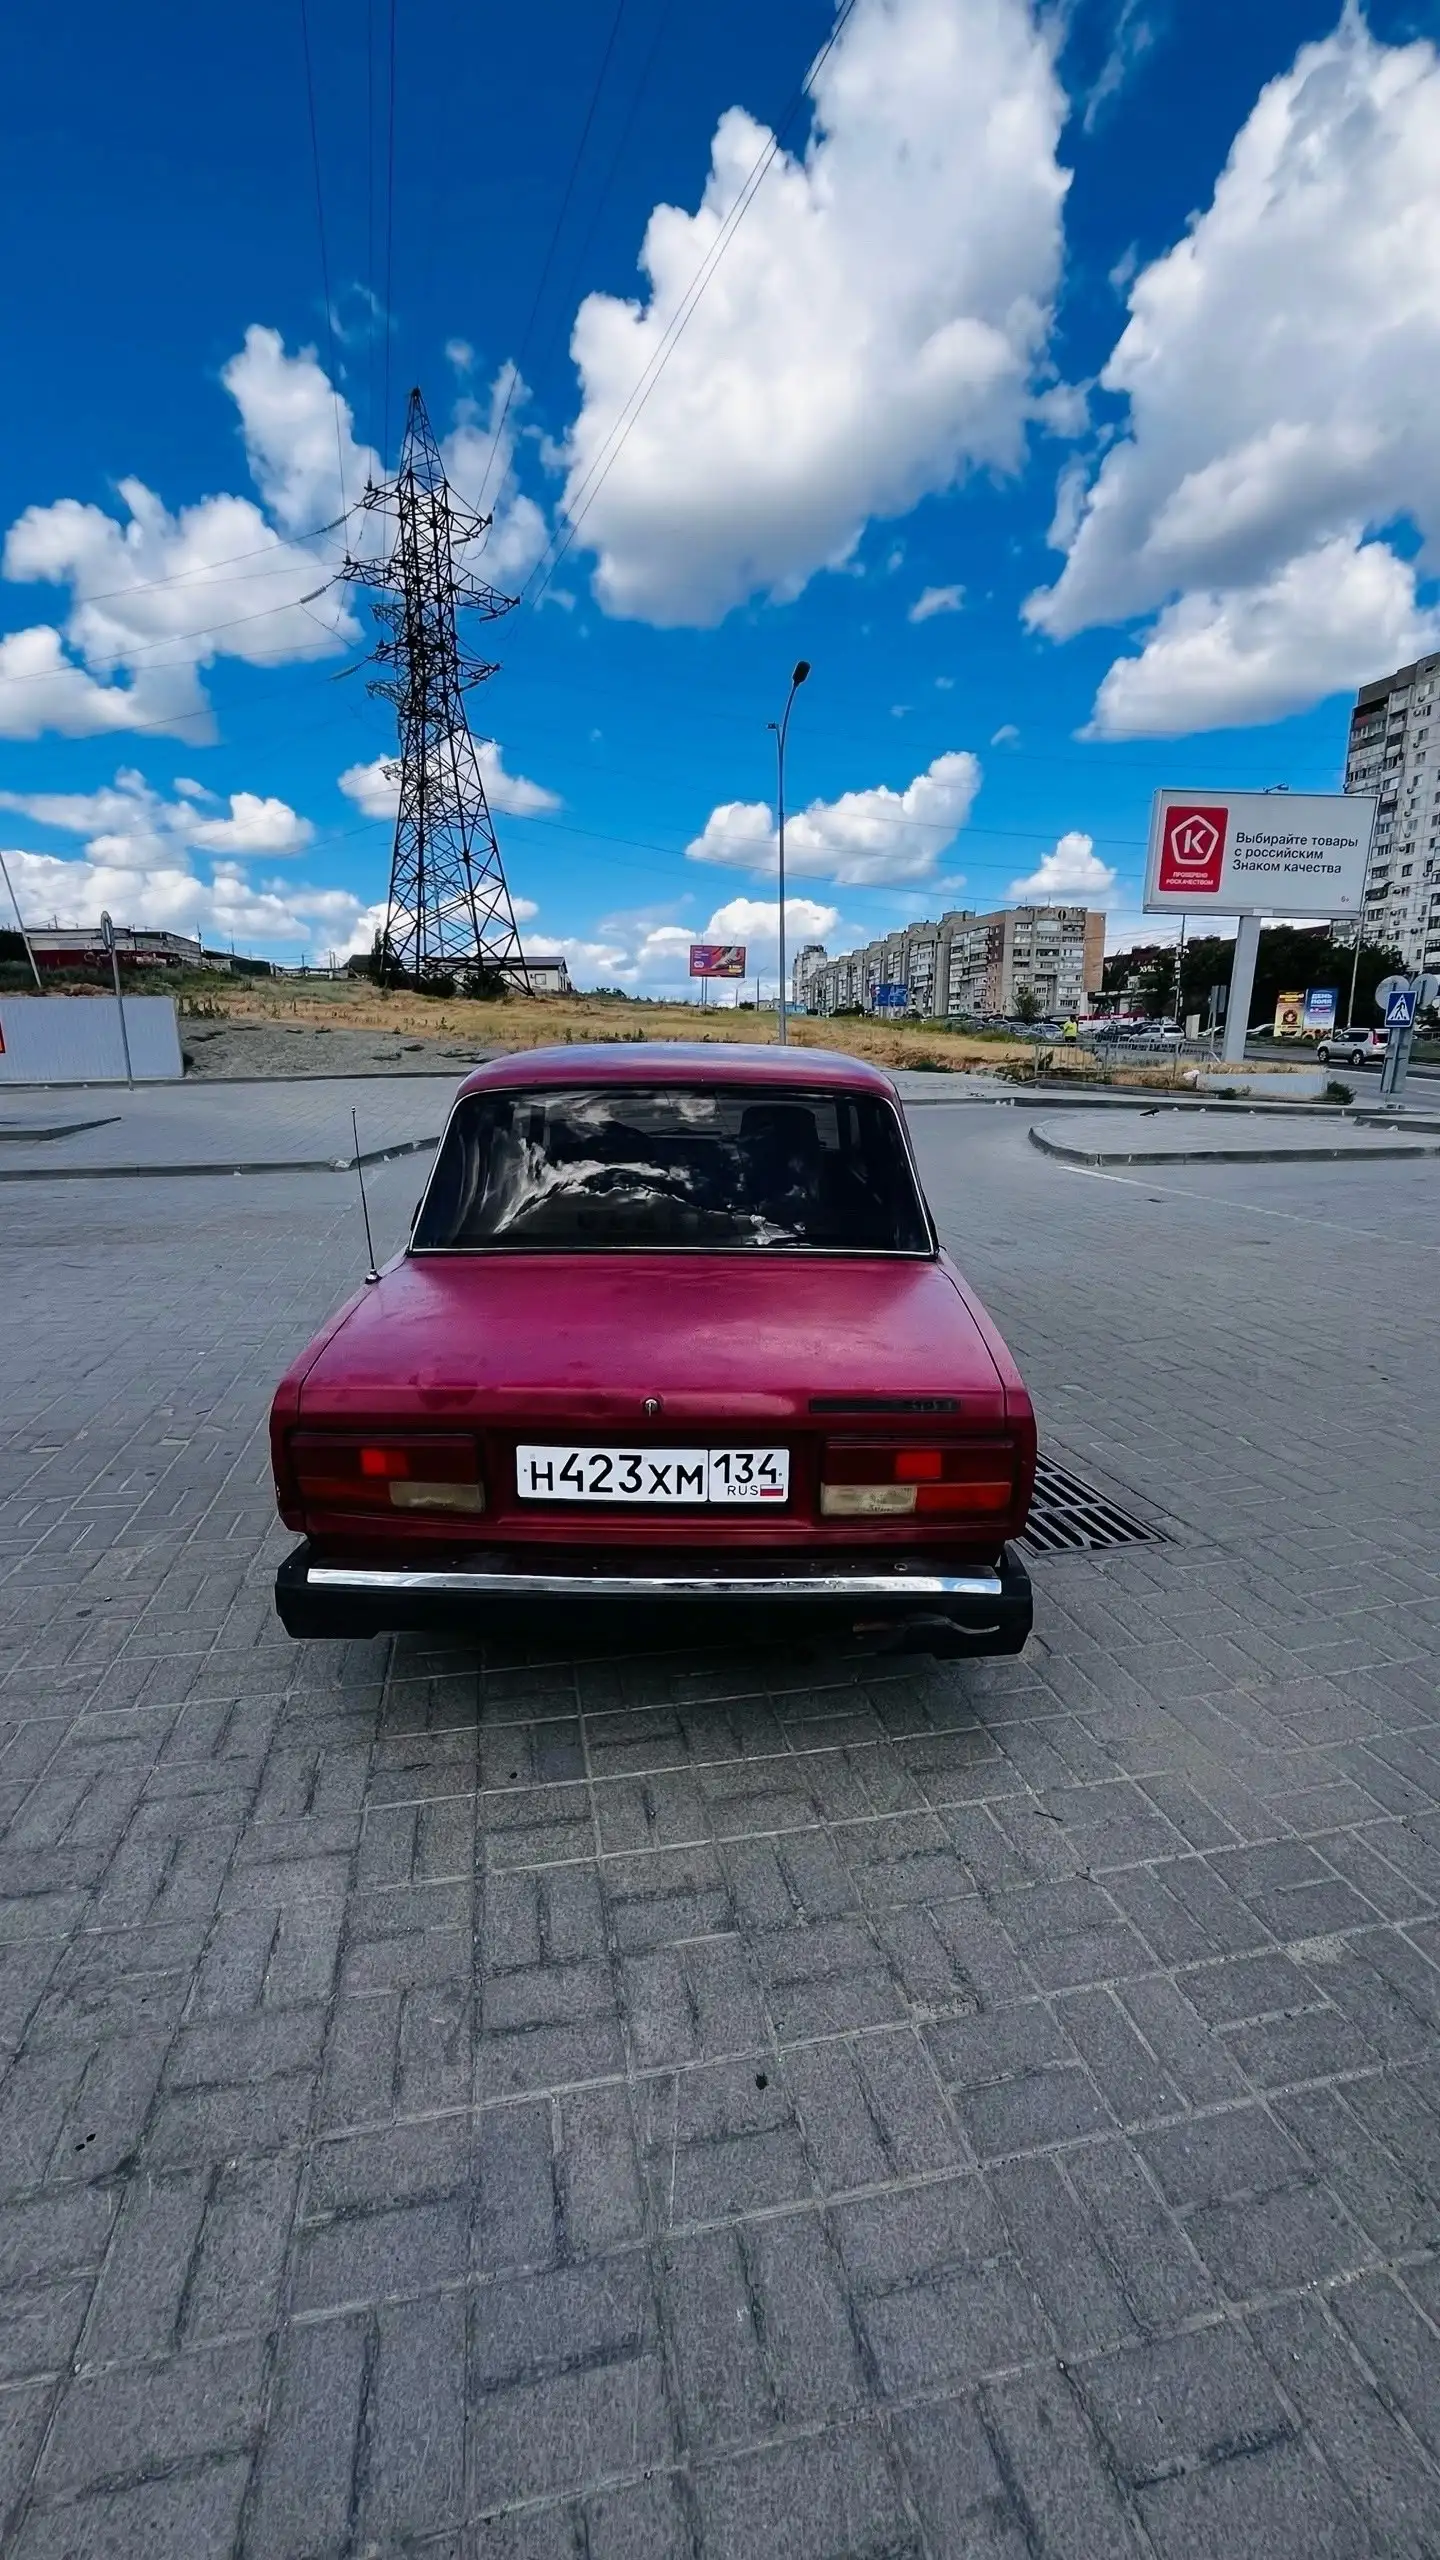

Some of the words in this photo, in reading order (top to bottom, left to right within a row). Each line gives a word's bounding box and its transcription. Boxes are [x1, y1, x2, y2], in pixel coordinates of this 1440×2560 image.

[1236, 832, 1307, 846] Выбирайте
[1311, 836, 1359, 848] товары
[1234, 849, 1242, 857] с
[1245, 847, 1324, 860] российским
[1232, 859, 1281, 872] Знаком
[1284, 863, 1342, 874] качества
[530, 1452, 703, 1495] Н423ХМ
[713, 1453, 777, 1484] 134
[727, 1484, 759, 1496] RUS
